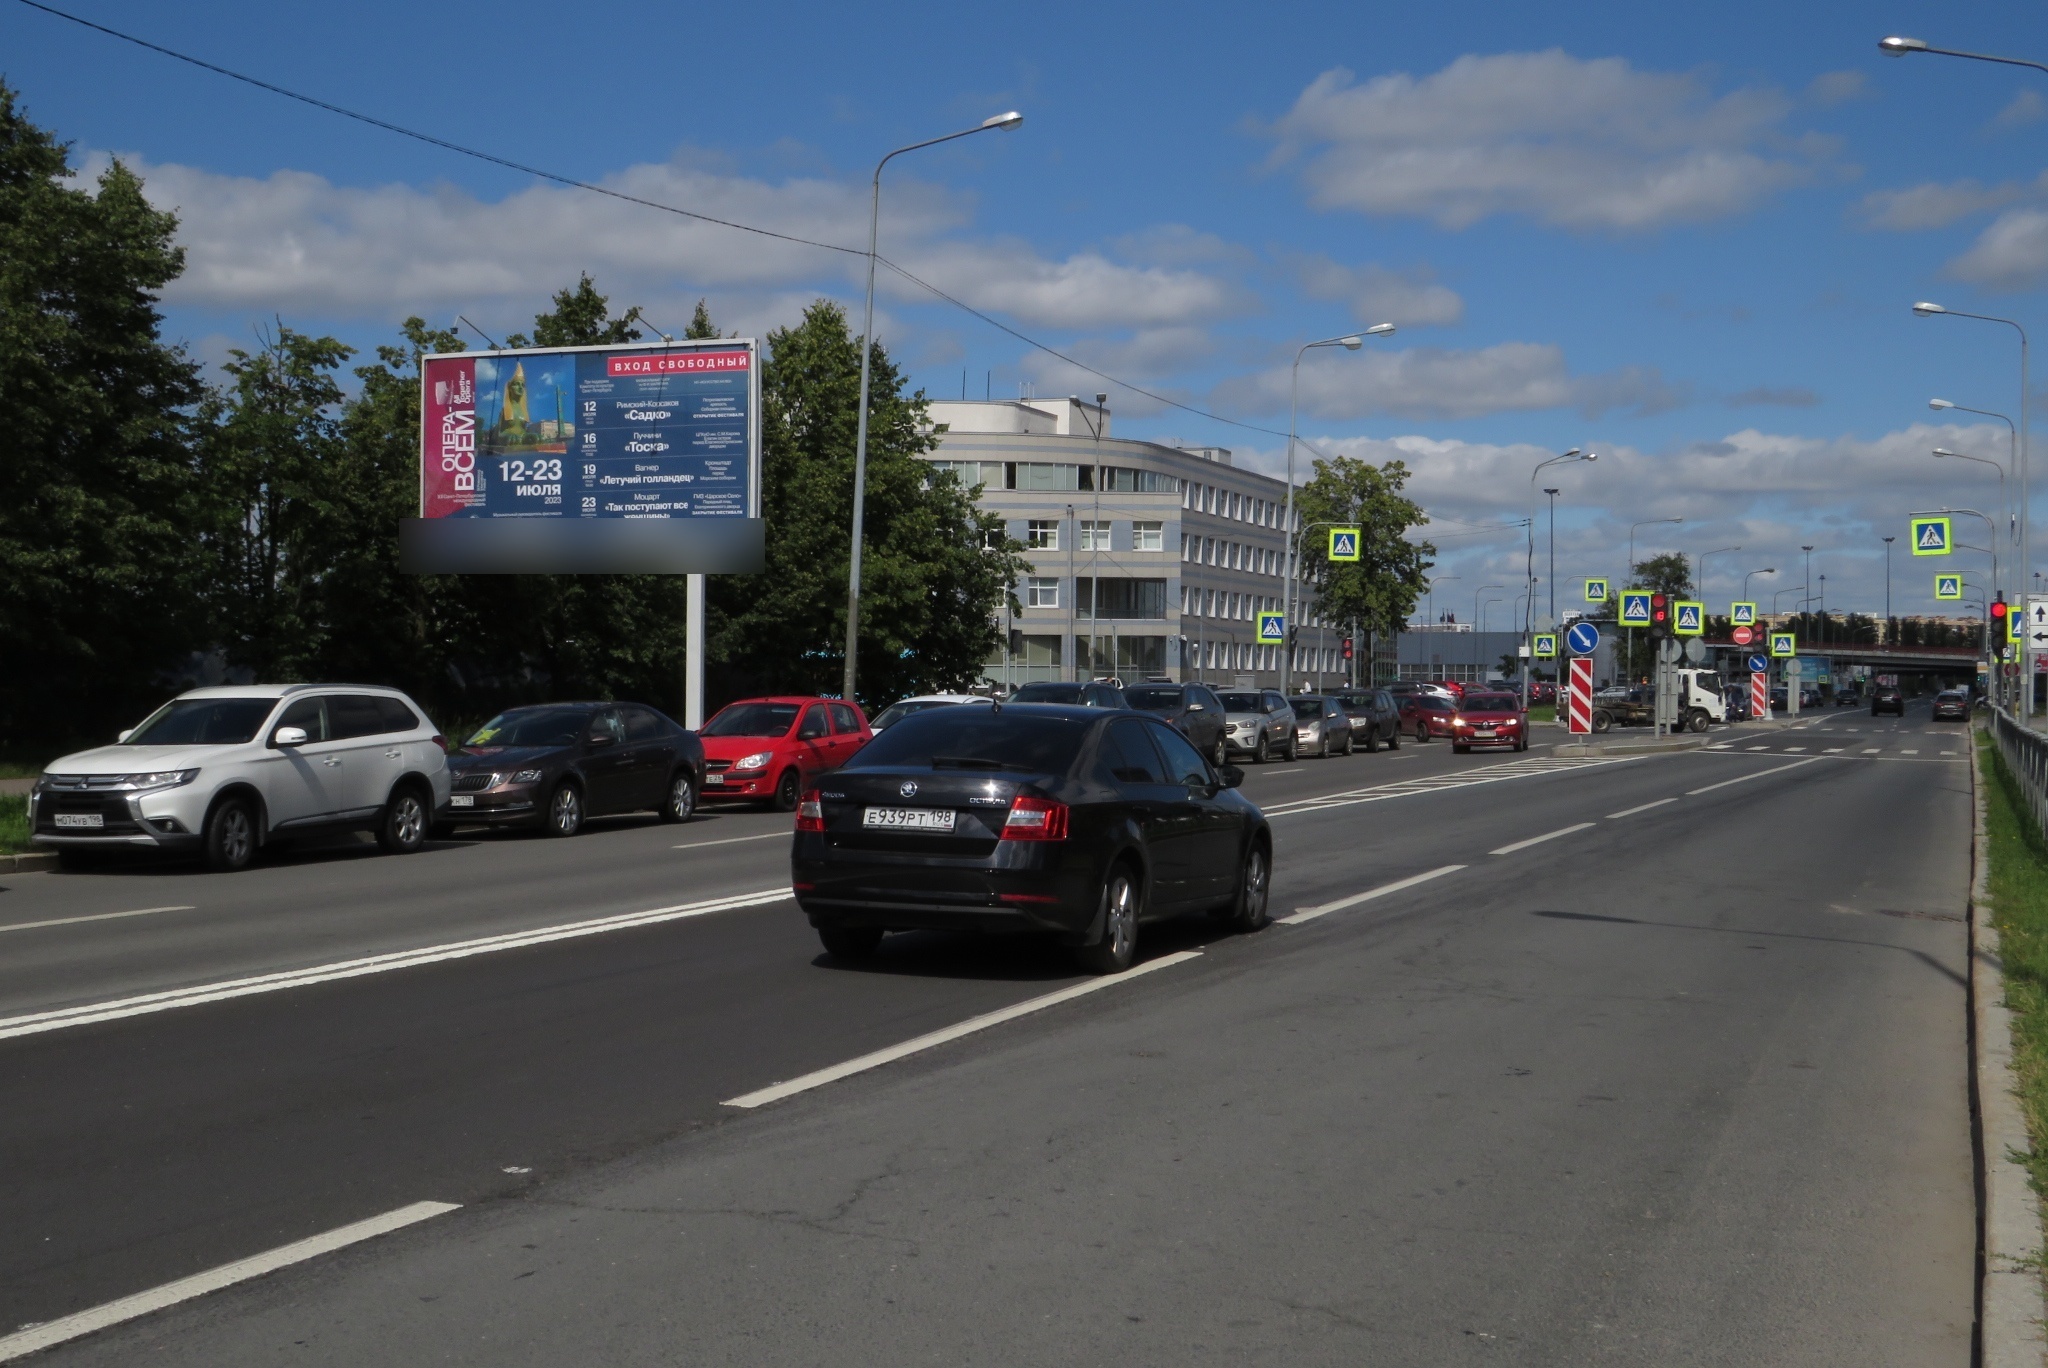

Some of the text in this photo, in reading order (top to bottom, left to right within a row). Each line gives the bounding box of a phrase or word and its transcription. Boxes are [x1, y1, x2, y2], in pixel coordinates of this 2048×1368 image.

[614, 355, 747, 372] ВХОД СВОБОДНЫЙ
[584, 401, 596, 412] 12
[624, 409, 671, 422] «Садко»
[442, 407, 456, 472] ОПЕРА-
[583, 433, 596, 444] 16
[454, 410, 475, 491] ВСЕМ
[624, 442, 670, 453] «Тоска»
[499, 459, 562, 482] 12-23
[582, 464, 596, 474] 19
[600, 475, 642, 486] «Летучий
[642, 474, 694, 484] голландец»
[544, 496, 562, 504] 2023
[581, 497, 596, 508] 23
[604, 503, 623, 512] «Так
[625, 502, 672, 512] поступают
[674, 502, 688, 510] все
[930, 810, 951, 822] 198
